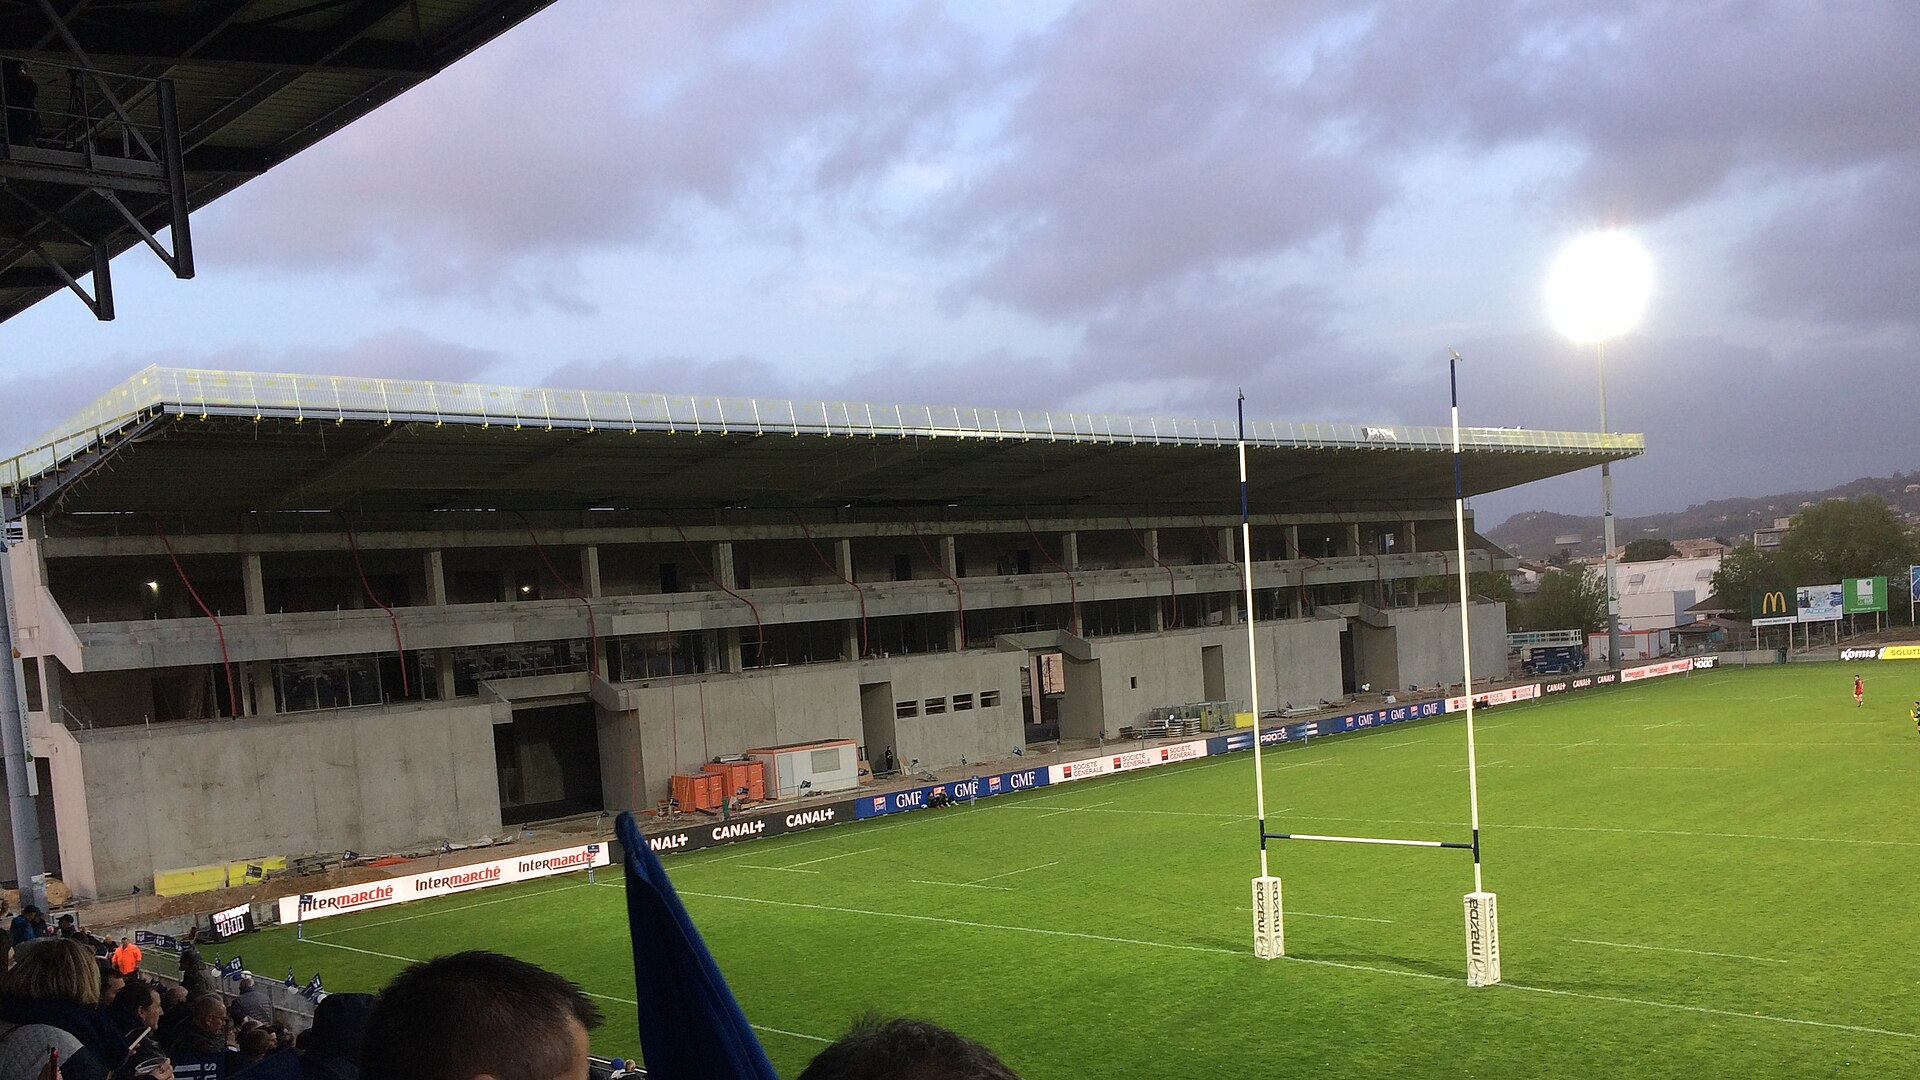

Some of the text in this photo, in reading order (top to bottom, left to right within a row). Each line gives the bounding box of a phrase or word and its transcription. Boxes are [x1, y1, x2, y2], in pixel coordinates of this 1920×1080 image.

[1841, 648, 1876, 661] Komis
[1547, 674, 1615, 692] CANAL+ CANAL+ CANAL+
[1358, 703, 1438, 726] GMF GMF GMF
[954, 781, 979, 798] GMF
[1010, 771, 1036, 788] GMF
[896, 791, 922, 808] GMF
[646, 807, 835, 851] NAL+ CANAL+ CANAL+
[302, 884, 393, 915] ntermarché
[415, 865, 501, 892] Intermarché
[1257, 881, 1265, 933] mazda
[1469, 898, 1481, 955] mazda
